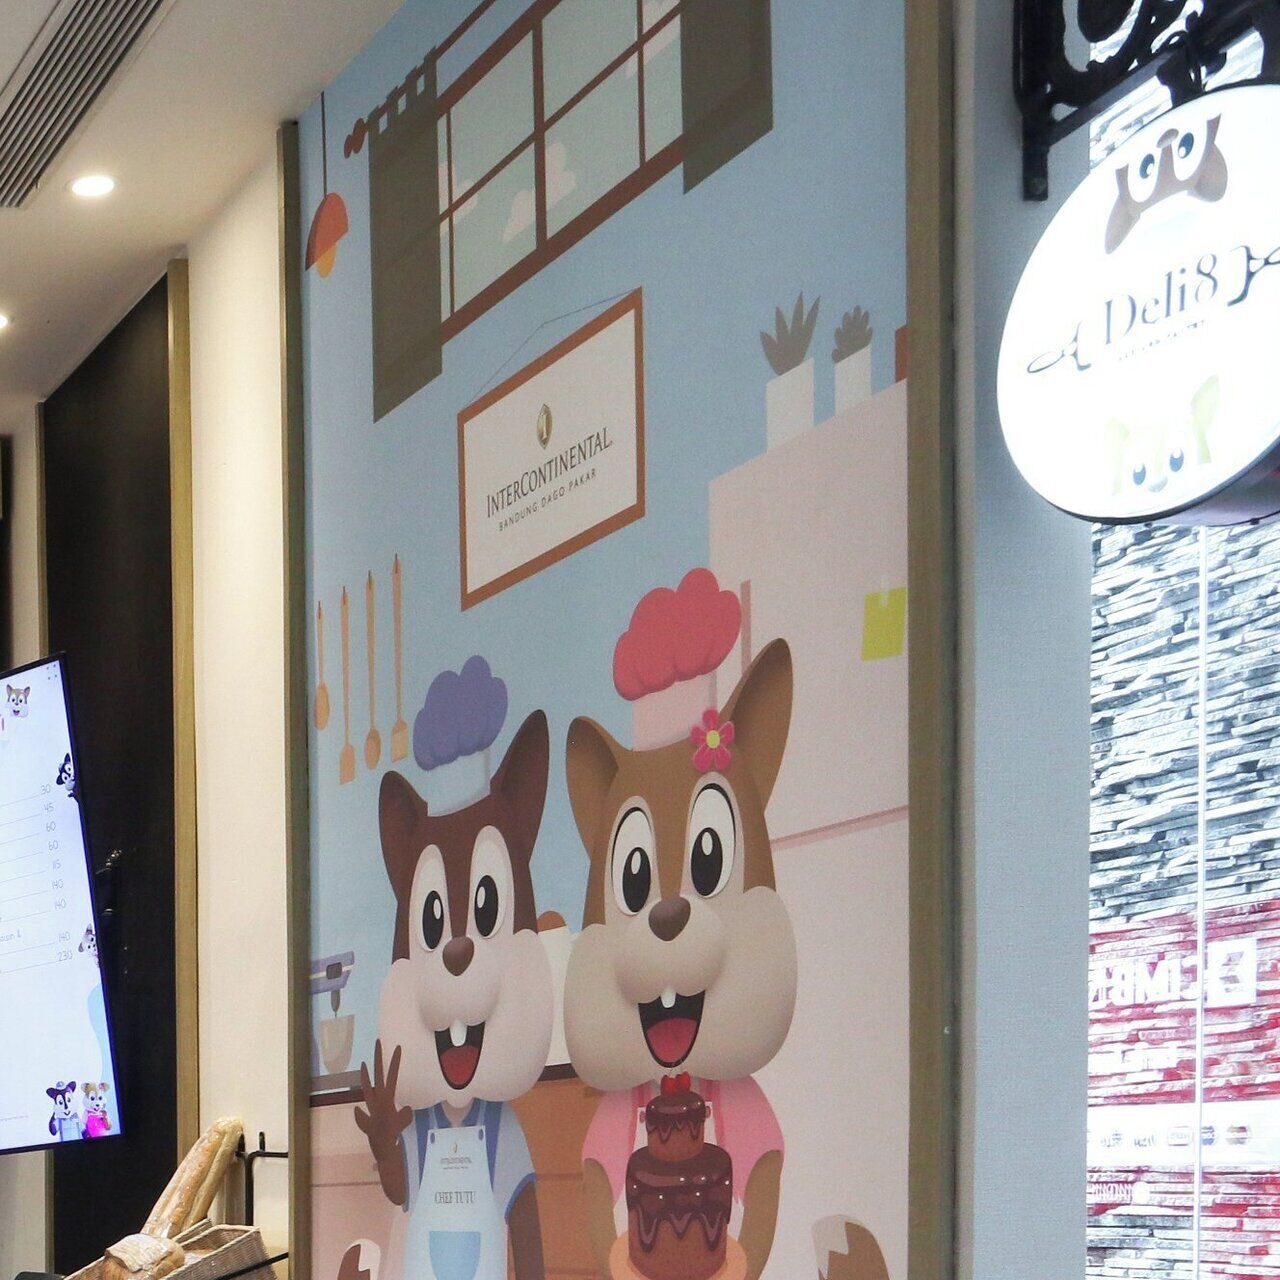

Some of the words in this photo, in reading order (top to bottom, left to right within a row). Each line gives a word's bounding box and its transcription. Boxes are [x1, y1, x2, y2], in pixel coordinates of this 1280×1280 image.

[1105, 254, 1218, 345] Deli8
[499, 503, 538, 531] BANDUNG
[541, 489, 565, 508] DAGO
[568, 468, 596, 492] PAKAR
[41, 784, 52, 795] 30
[44, 803, 55, 813] 45
[46, 821, 56, 832] 60
[48, 840, 59, 851] 60
[434, 1191, 453, 1205] CHEF
[454, 1190, 477, 1204] TUTU
